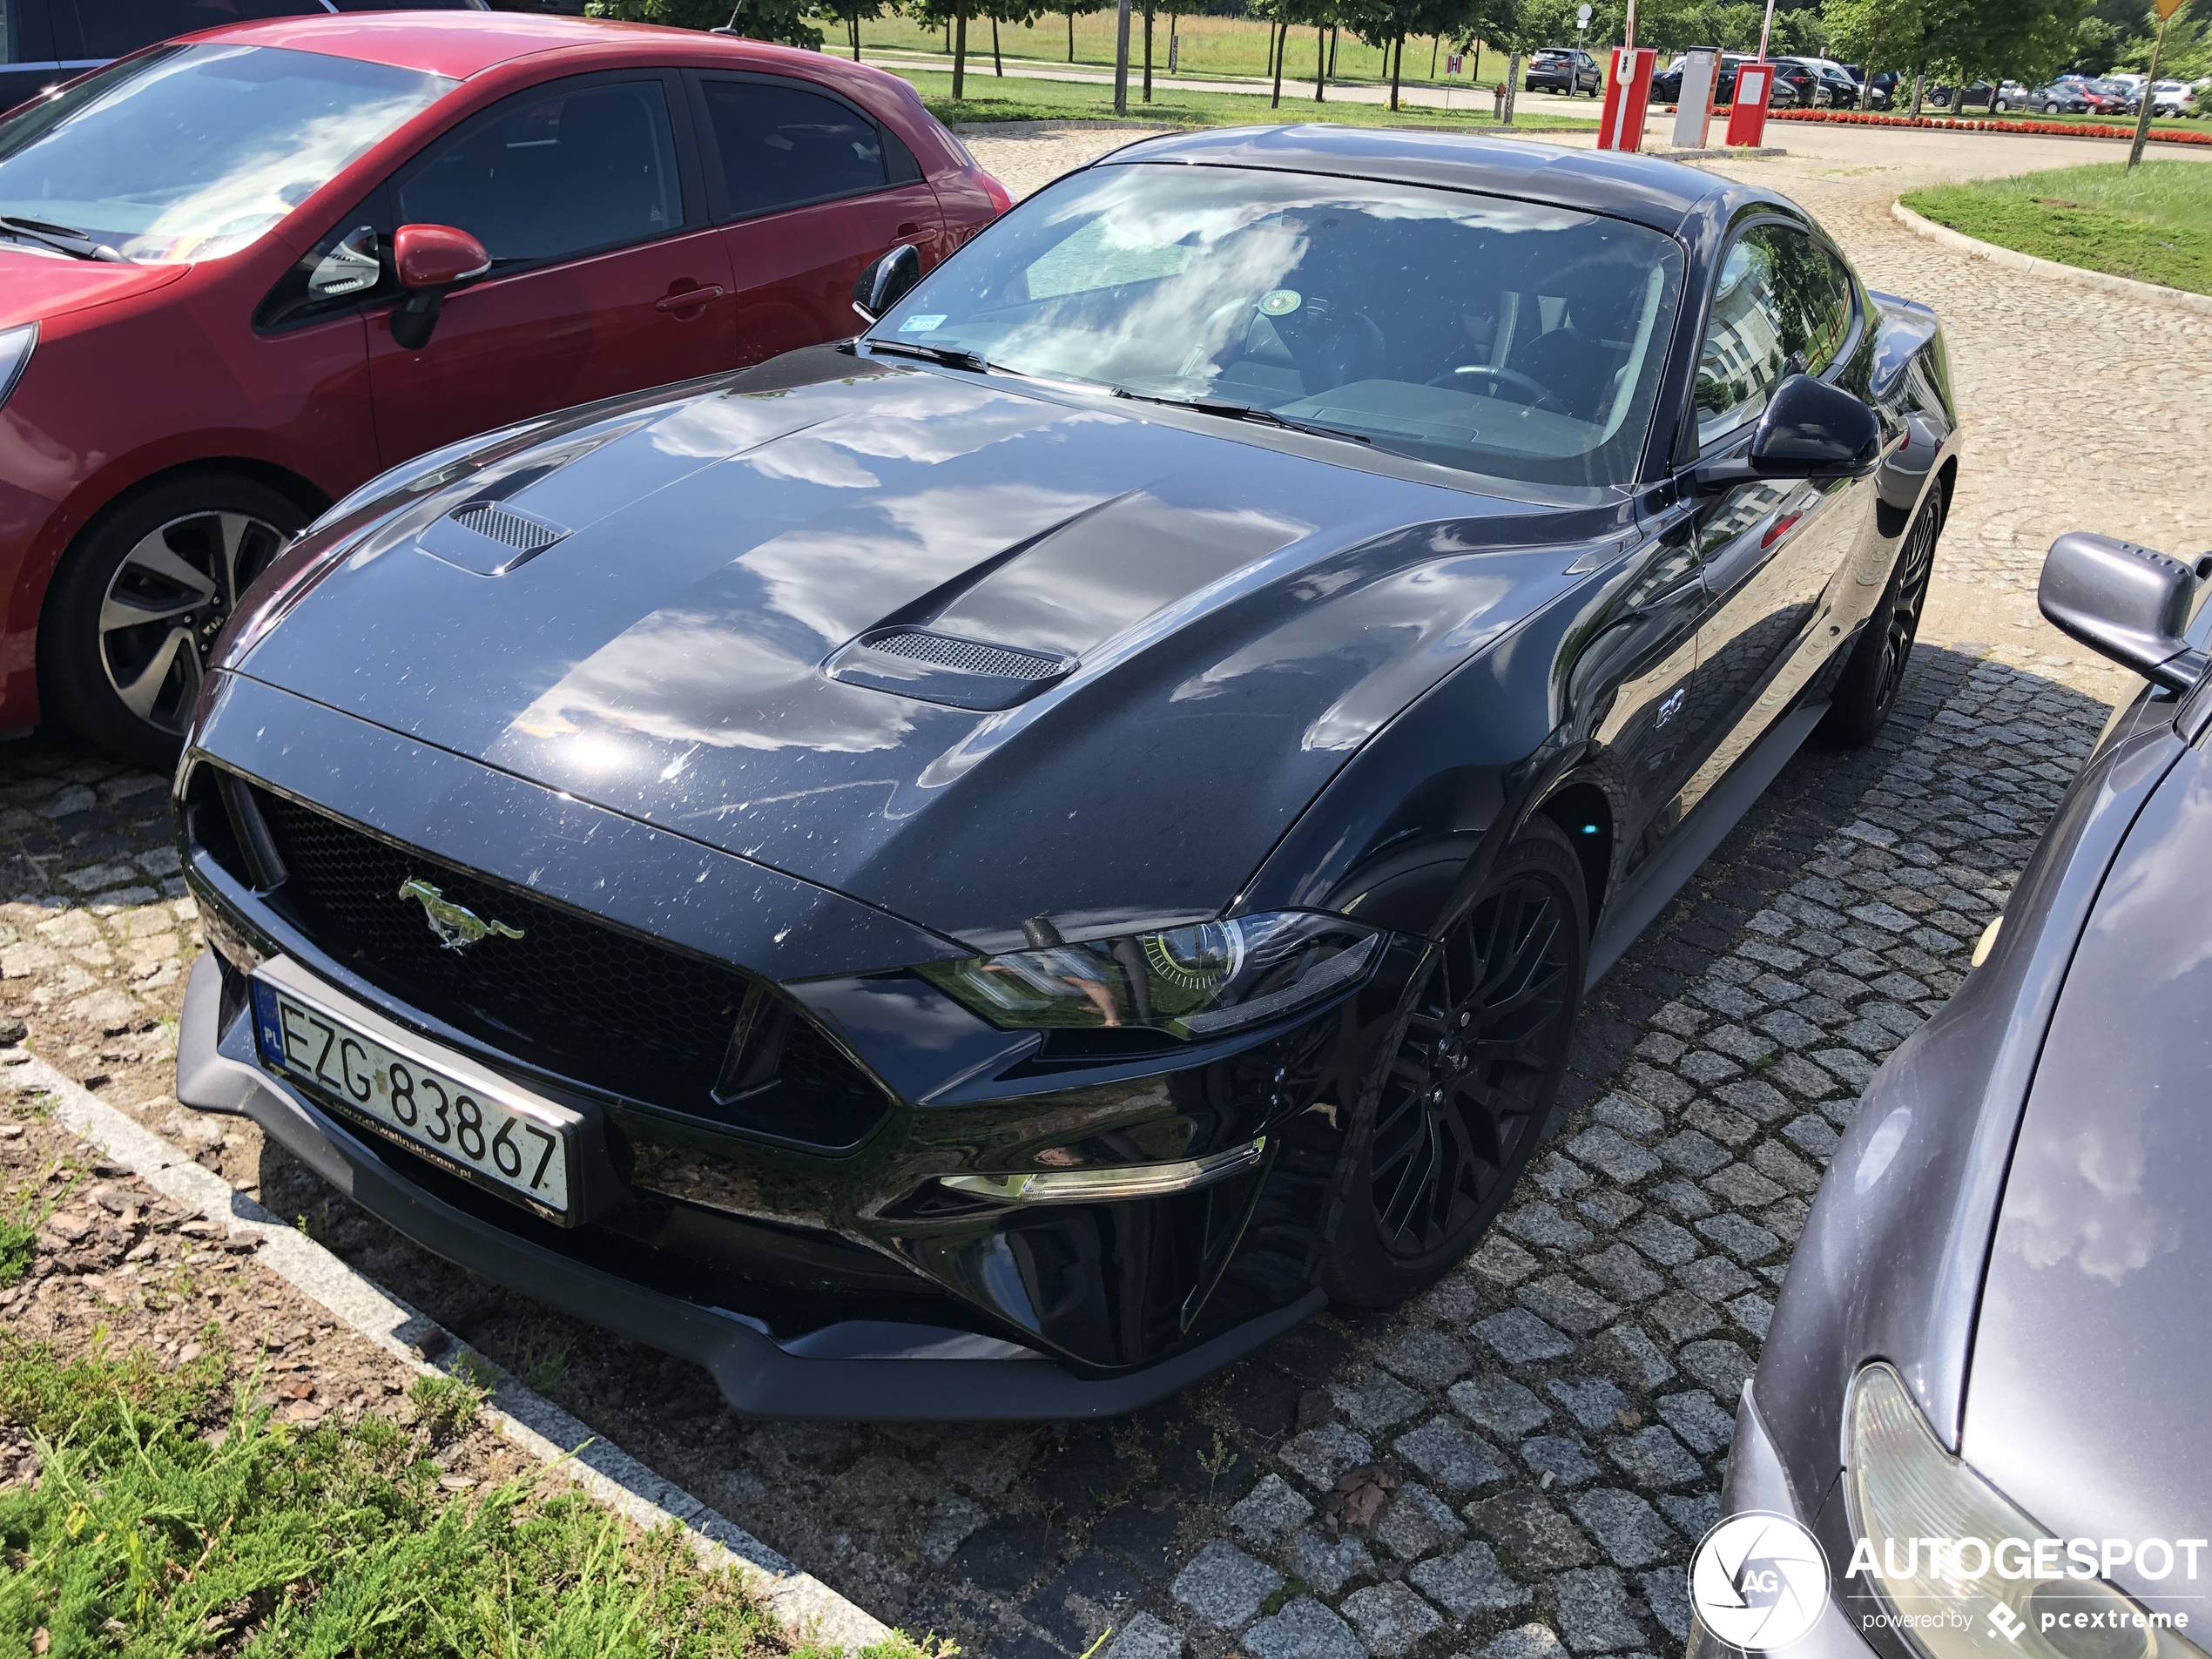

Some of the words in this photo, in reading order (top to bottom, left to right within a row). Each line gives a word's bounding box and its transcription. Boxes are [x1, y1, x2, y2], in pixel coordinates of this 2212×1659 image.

[1451, 57, 1459, 72] H
[263, 1027, 281, 1050] PL
[280, 1001, 371, 1103] EZG
[388, 1062, 556, 1190] 83867
